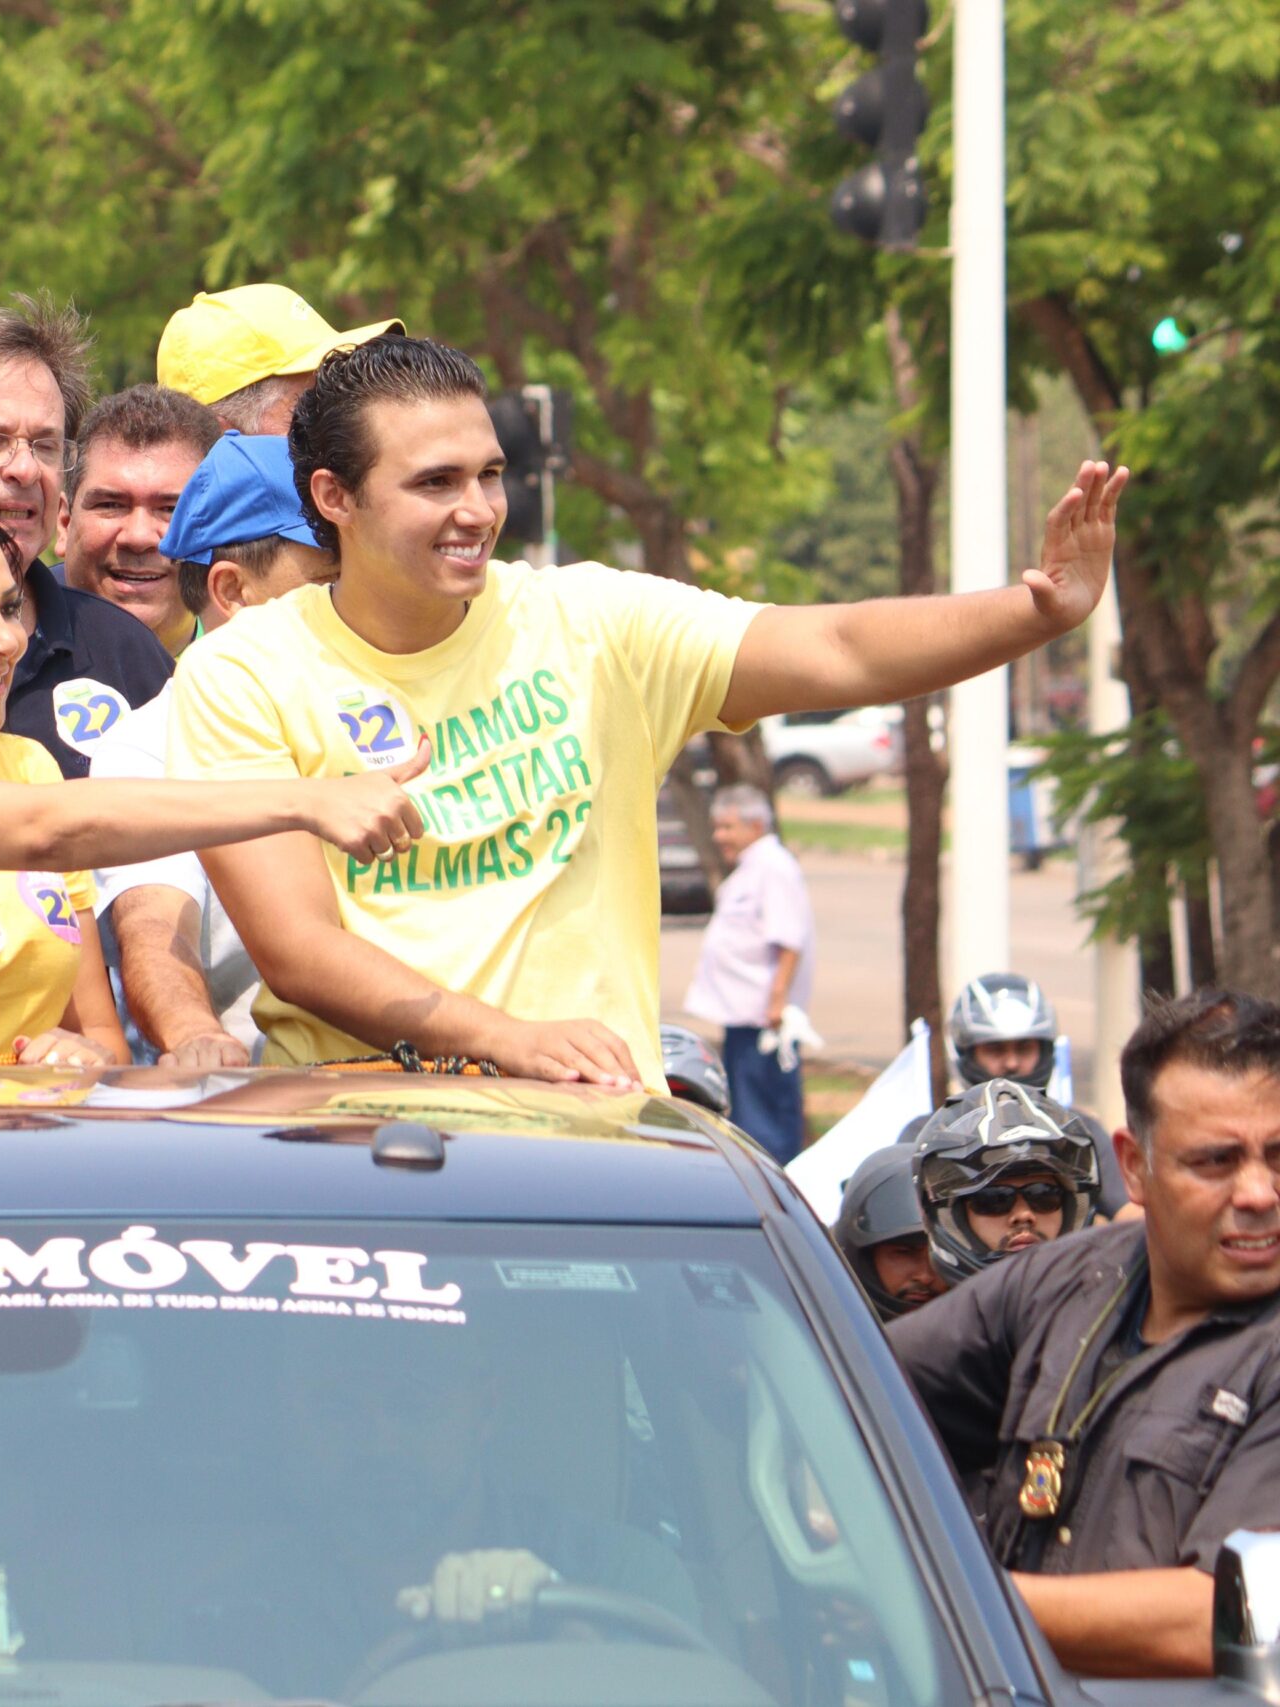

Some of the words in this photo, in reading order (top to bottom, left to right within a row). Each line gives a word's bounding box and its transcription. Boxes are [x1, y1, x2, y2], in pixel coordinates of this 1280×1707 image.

[418, 669, 569, 777] VAMOS
[347, 821, 534, 894] PALMAS
[36, 888, 78, 929] 2
[48, 1293, 120, 1308] ACIMA
[122, 1293, 154, 1309] DE
[155, 1294, 218, 1310] TUDO
[219, 1295, 279, 1312] DEUS
[281, 1298, 353, 1316] ACIMA
[355, 1302, 387, 1318] DE
